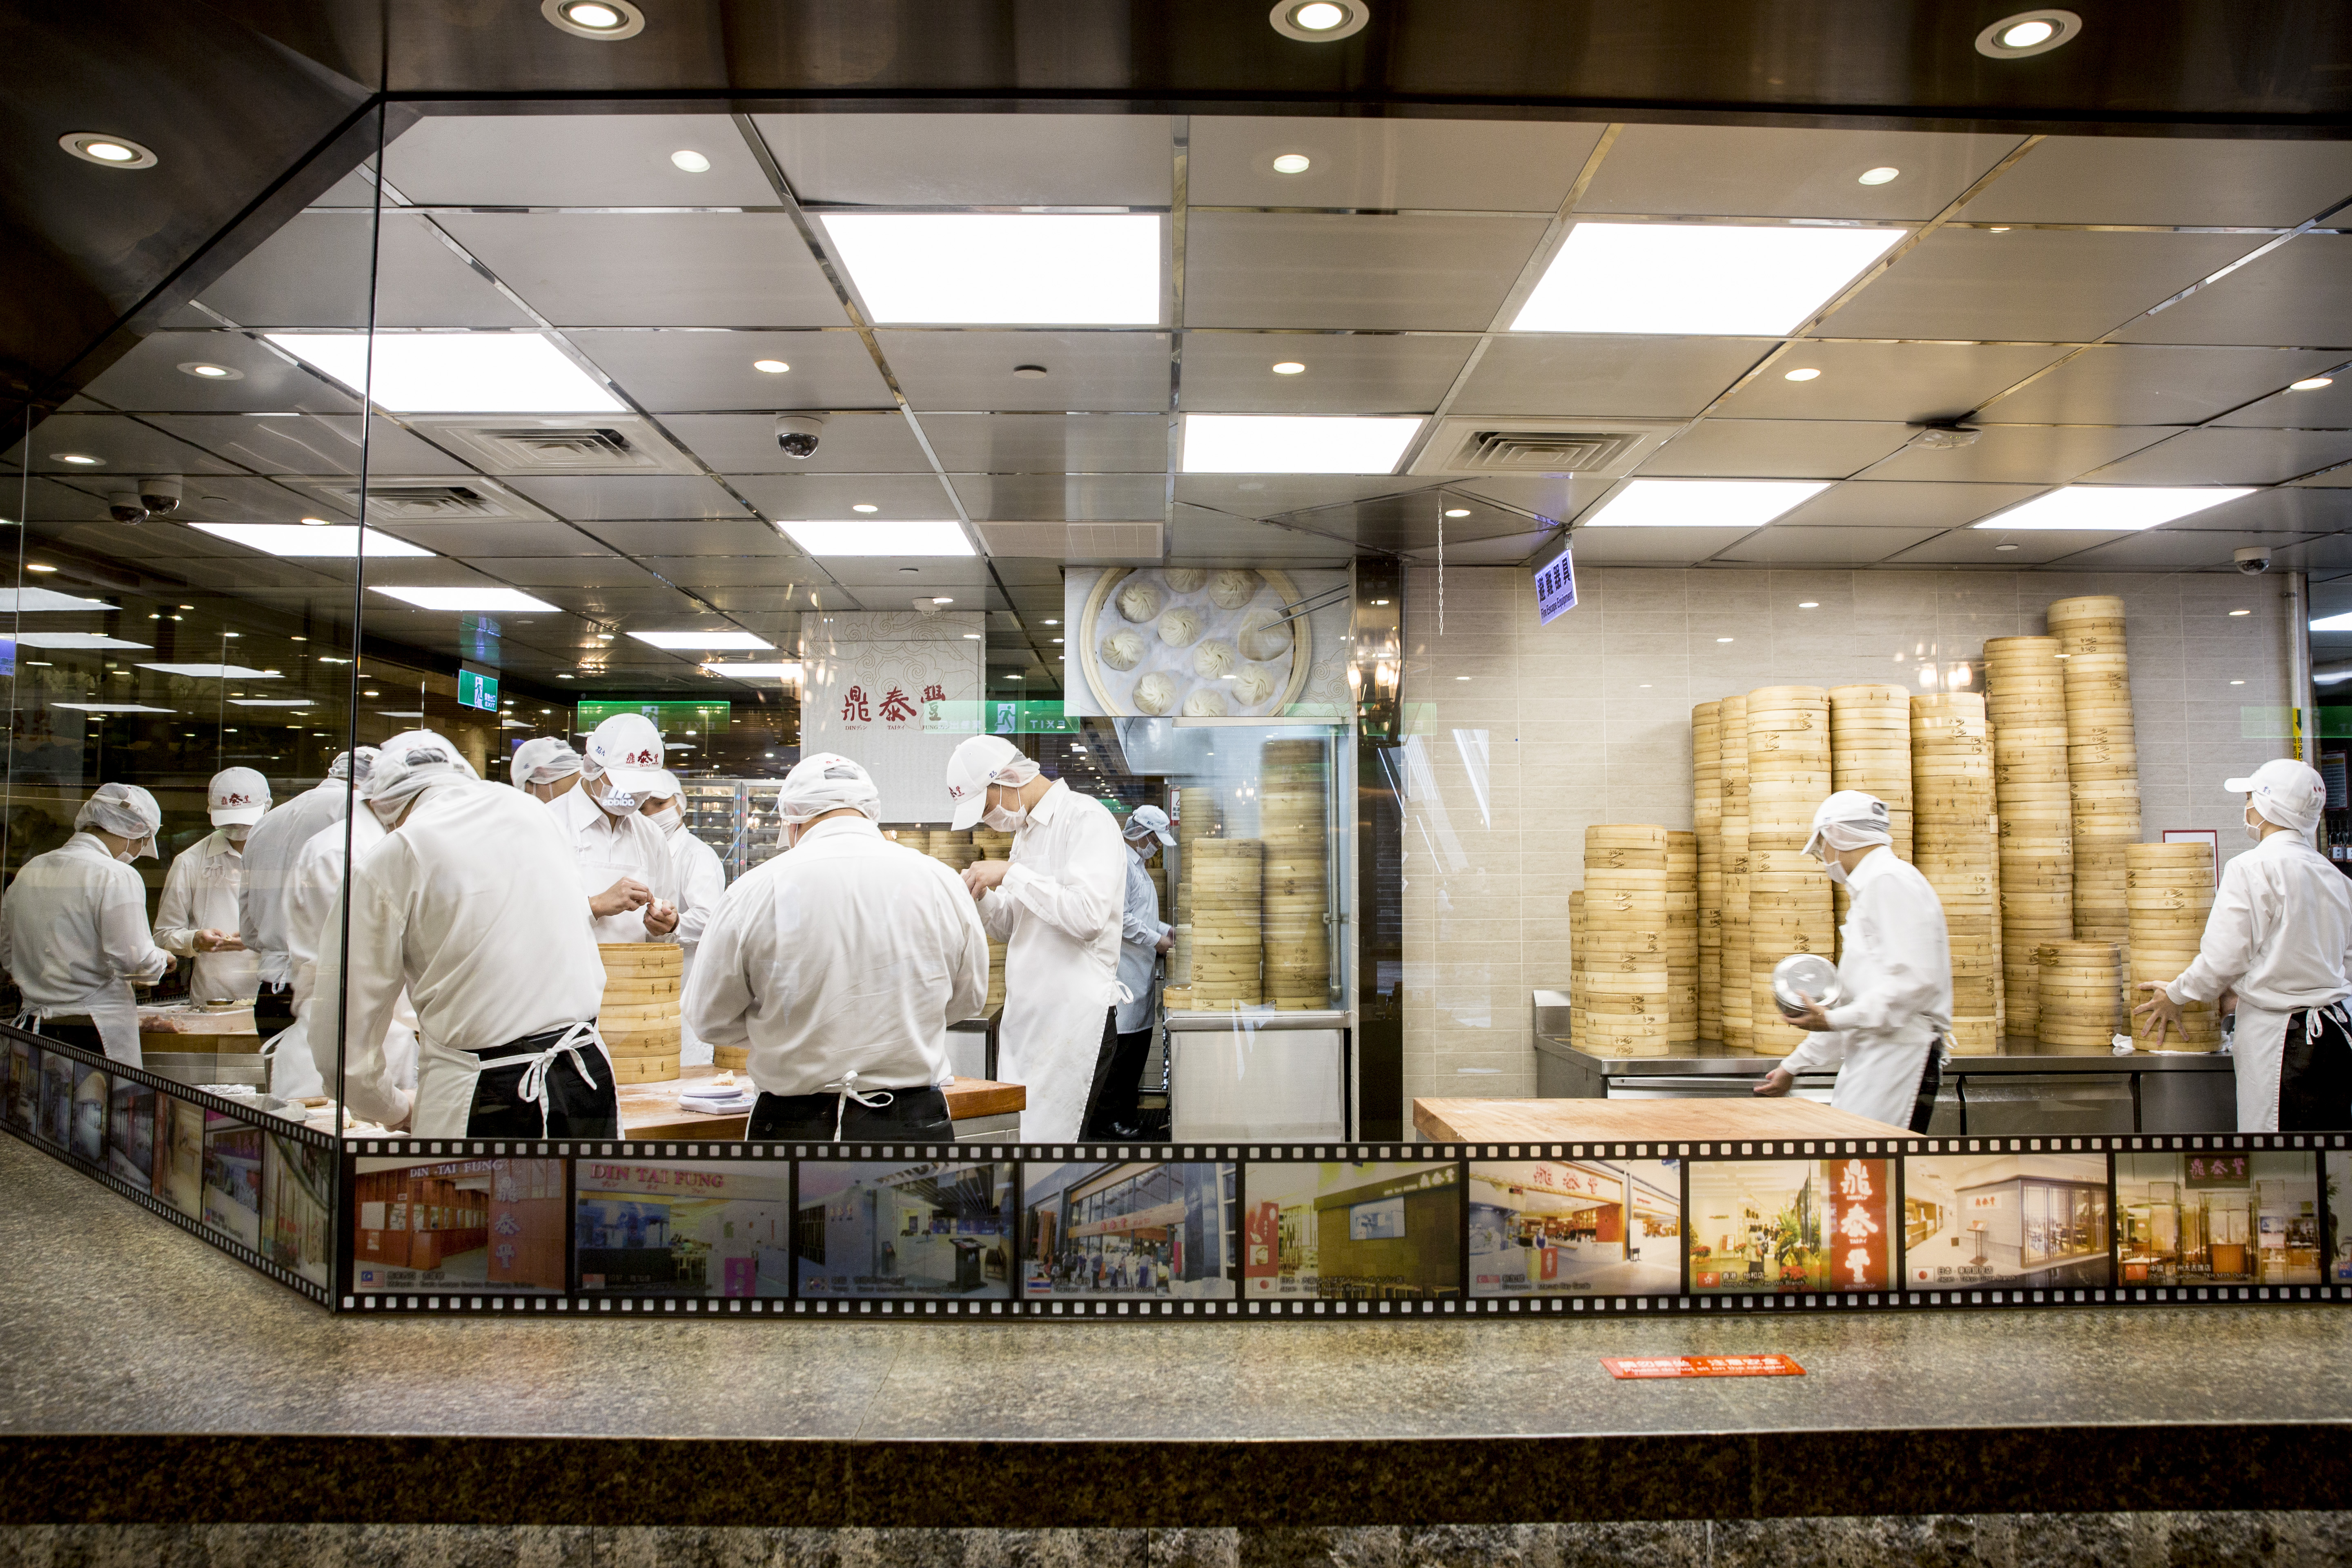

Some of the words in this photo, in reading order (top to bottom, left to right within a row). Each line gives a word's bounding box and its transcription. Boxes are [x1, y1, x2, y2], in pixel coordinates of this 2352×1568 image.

[1546, 604, 1557, 615] Escape
[1557, 589, 1573, 609] Equipment
[841, 685, 946, 722] 鼎泰豐
[410, 1167, 429, 1178] DIN
[437, 1164, 456, 1175] TAI
[464, 1160, 503, 1173] FUNG
[590, 1164, 630, 1180] DIN
[635, 1167, 668, 1183] TAI
[675, 1171, 724, 1187] FUNG
